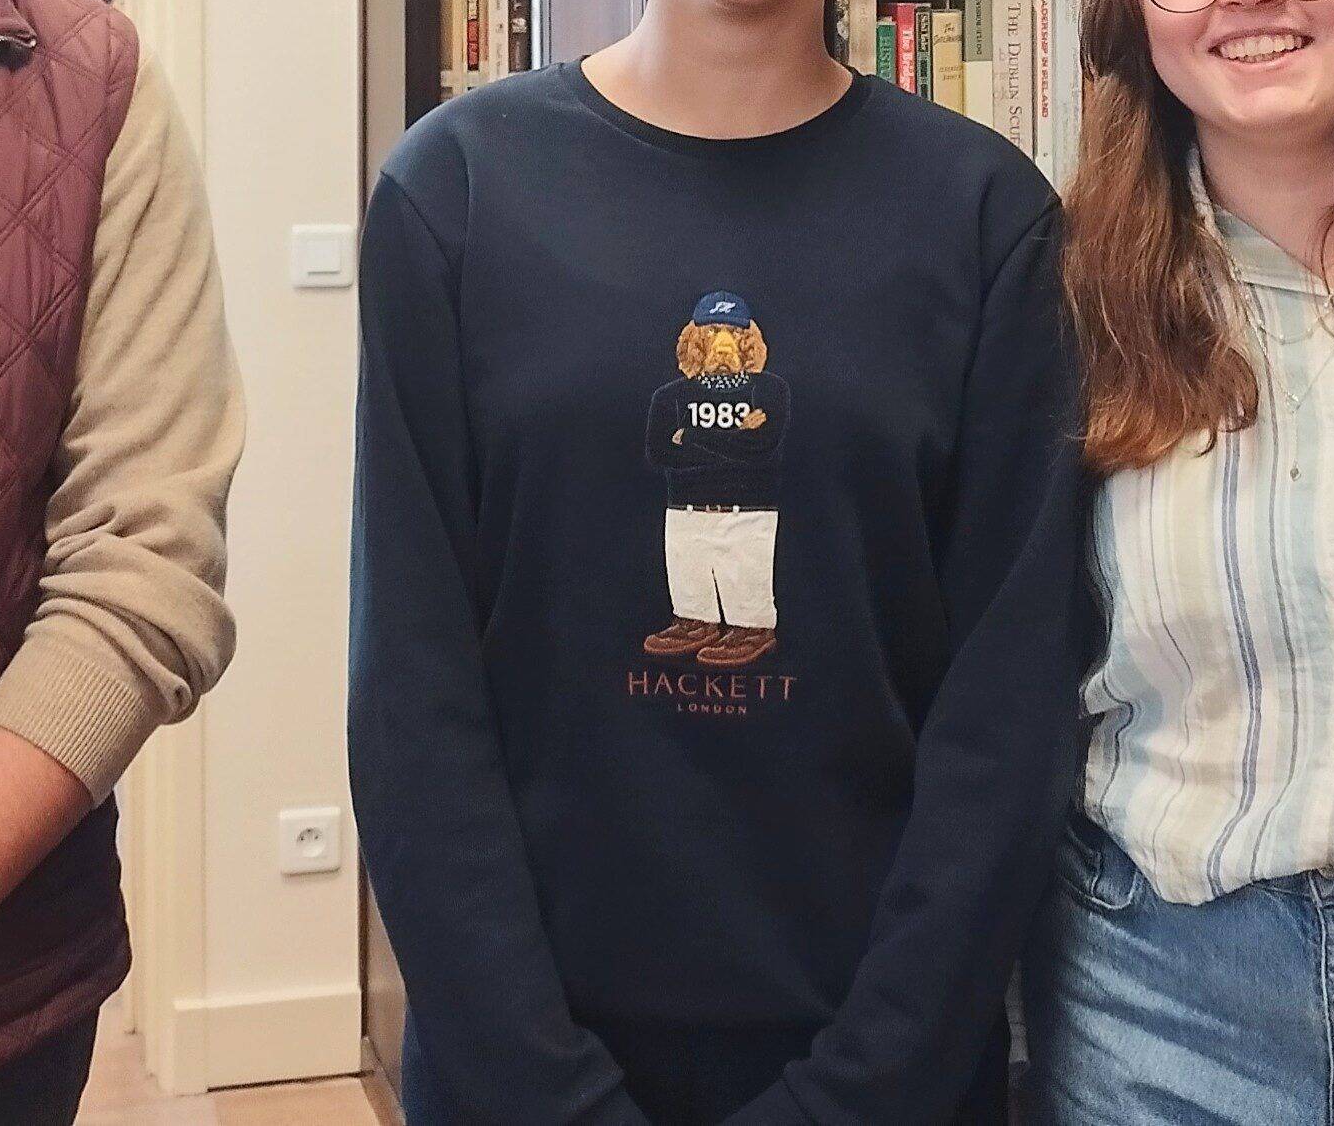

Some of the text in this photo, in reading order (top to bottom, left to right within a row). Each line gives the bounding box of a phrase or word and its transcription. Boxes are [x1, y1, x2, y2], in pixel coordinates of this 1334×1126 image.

[1007, 2, 1022, 37] THE
[1041, 56, 1049, 68] IN
[1041, 69, 1050, 118] IRELAND
[688, 402, 751, 429] 1983
[627, 671, 800, 702] HACKETT
[677, 703, 748, 715] LONDON
